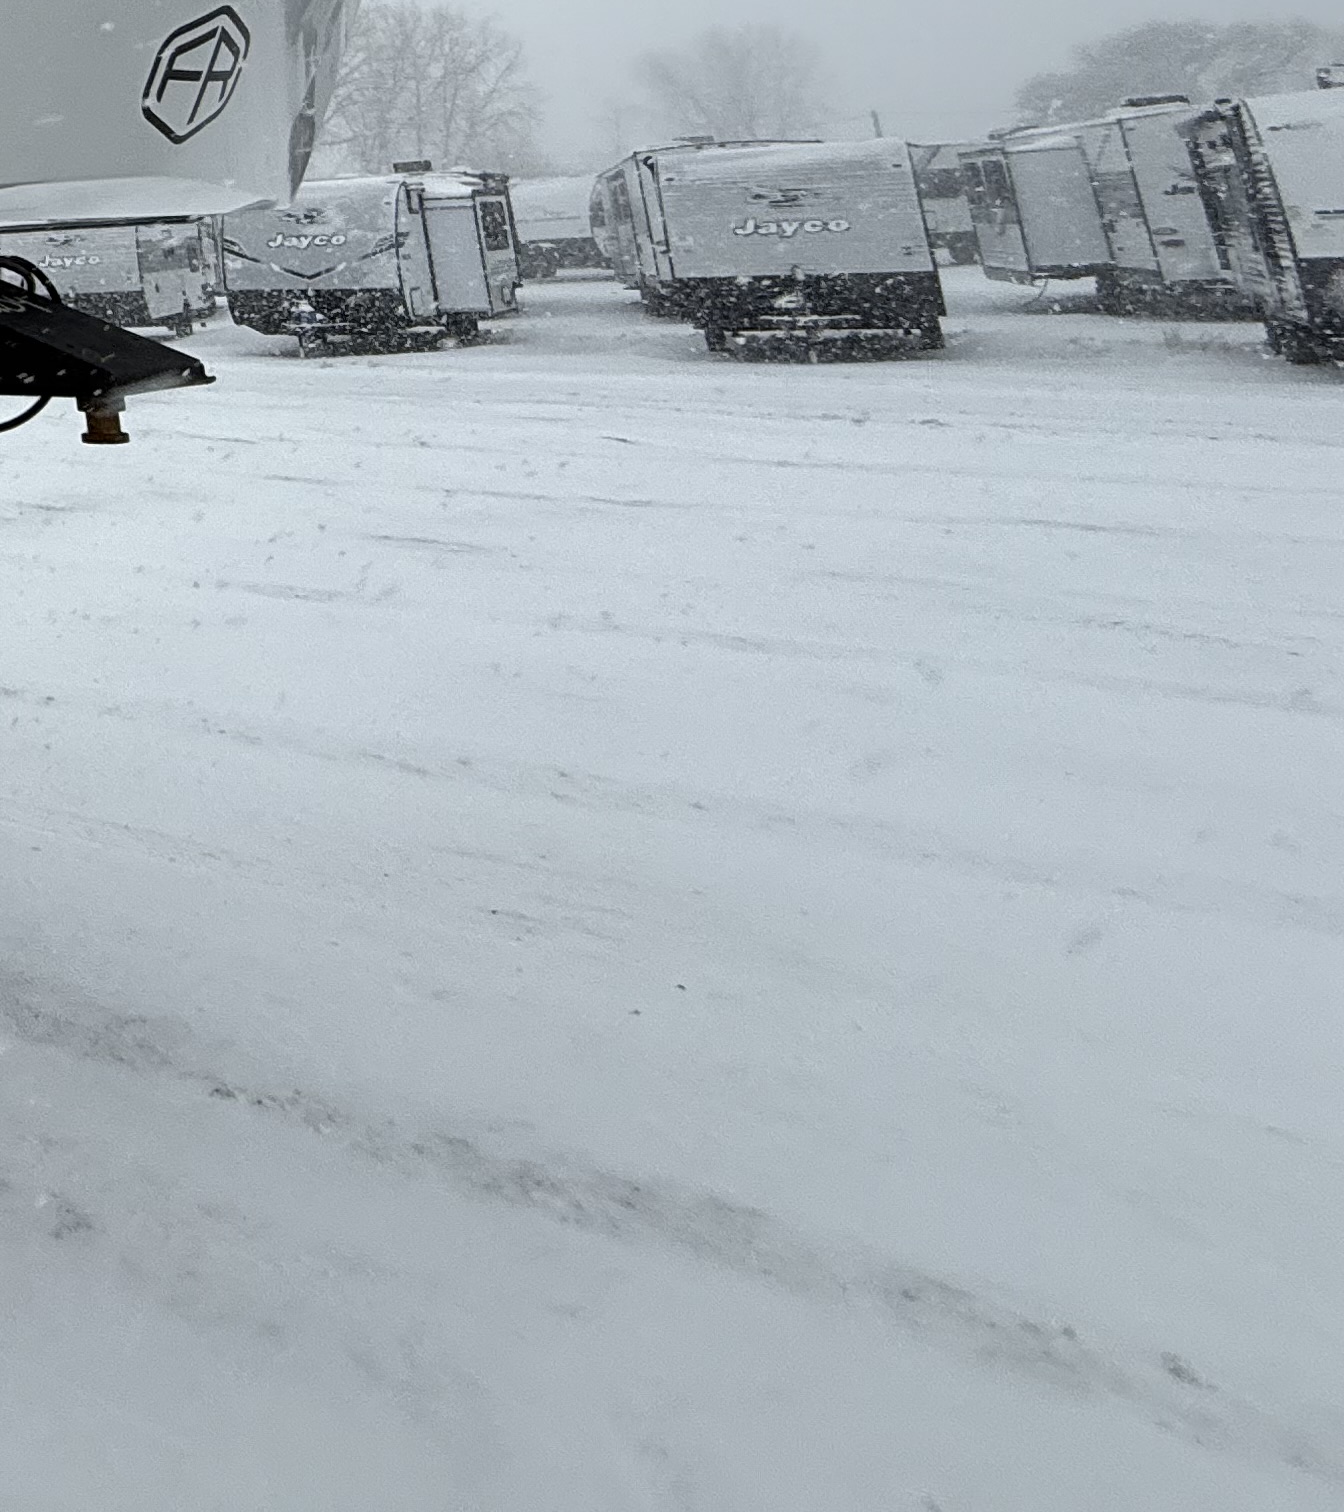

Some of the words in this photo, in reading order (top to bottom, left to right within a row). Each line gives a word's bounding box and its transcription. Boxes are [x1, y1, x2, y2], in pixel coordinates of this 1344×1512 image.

[733, 219, 851, 239] Jayco
[267, 232, 347, 250] Jayco
[38, 254, 101, 269] Jayco
